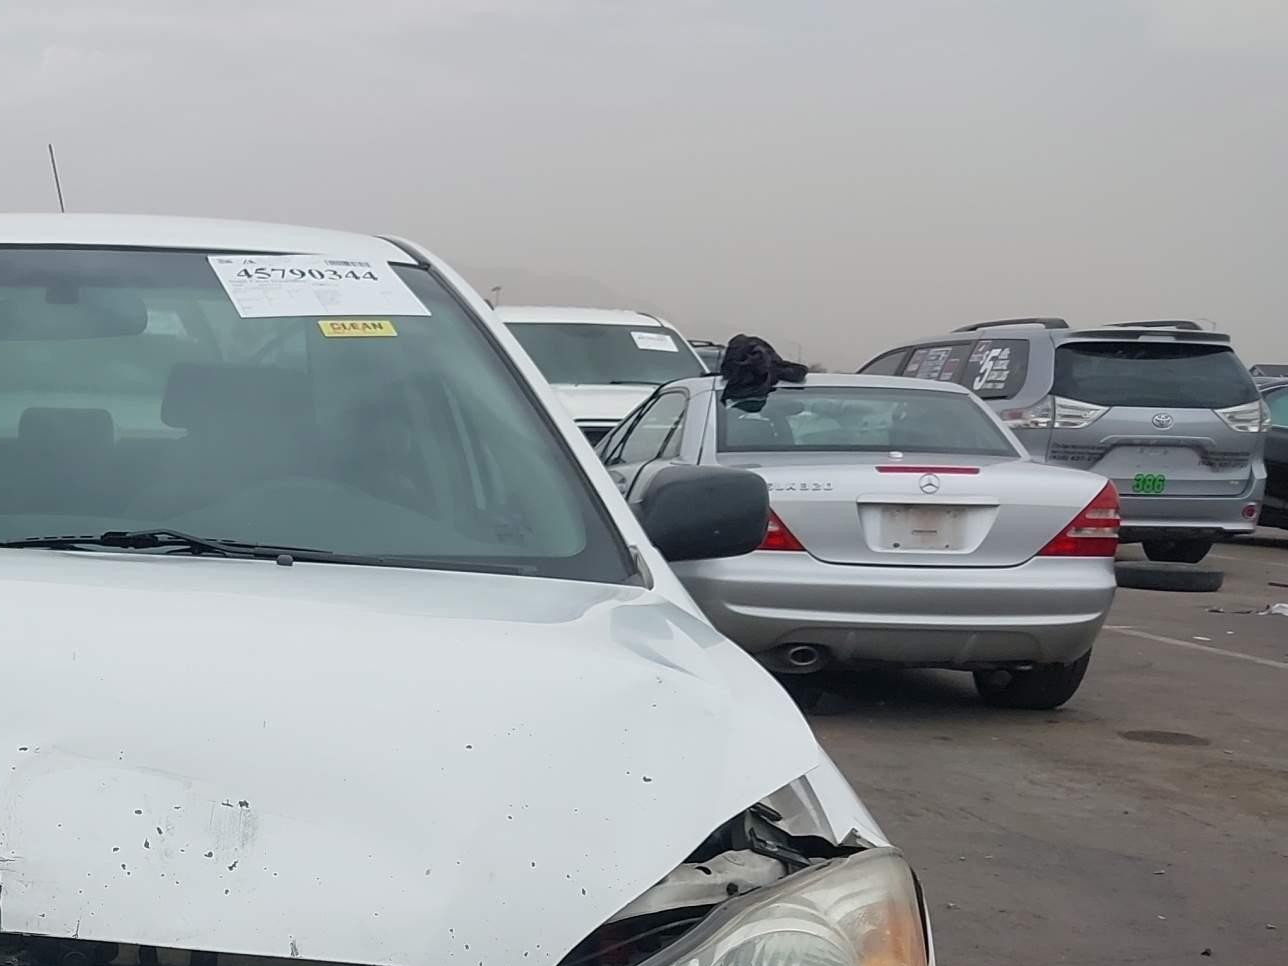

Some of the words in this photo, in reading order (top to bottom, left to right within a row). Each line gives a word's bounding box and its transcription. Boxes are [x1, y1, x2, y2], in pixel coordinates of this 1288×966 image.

[236, 267, 379, 282] 45790344
[329, 321, 384, 331] CLEAN
[1132, 473, 1165, 494] 386
